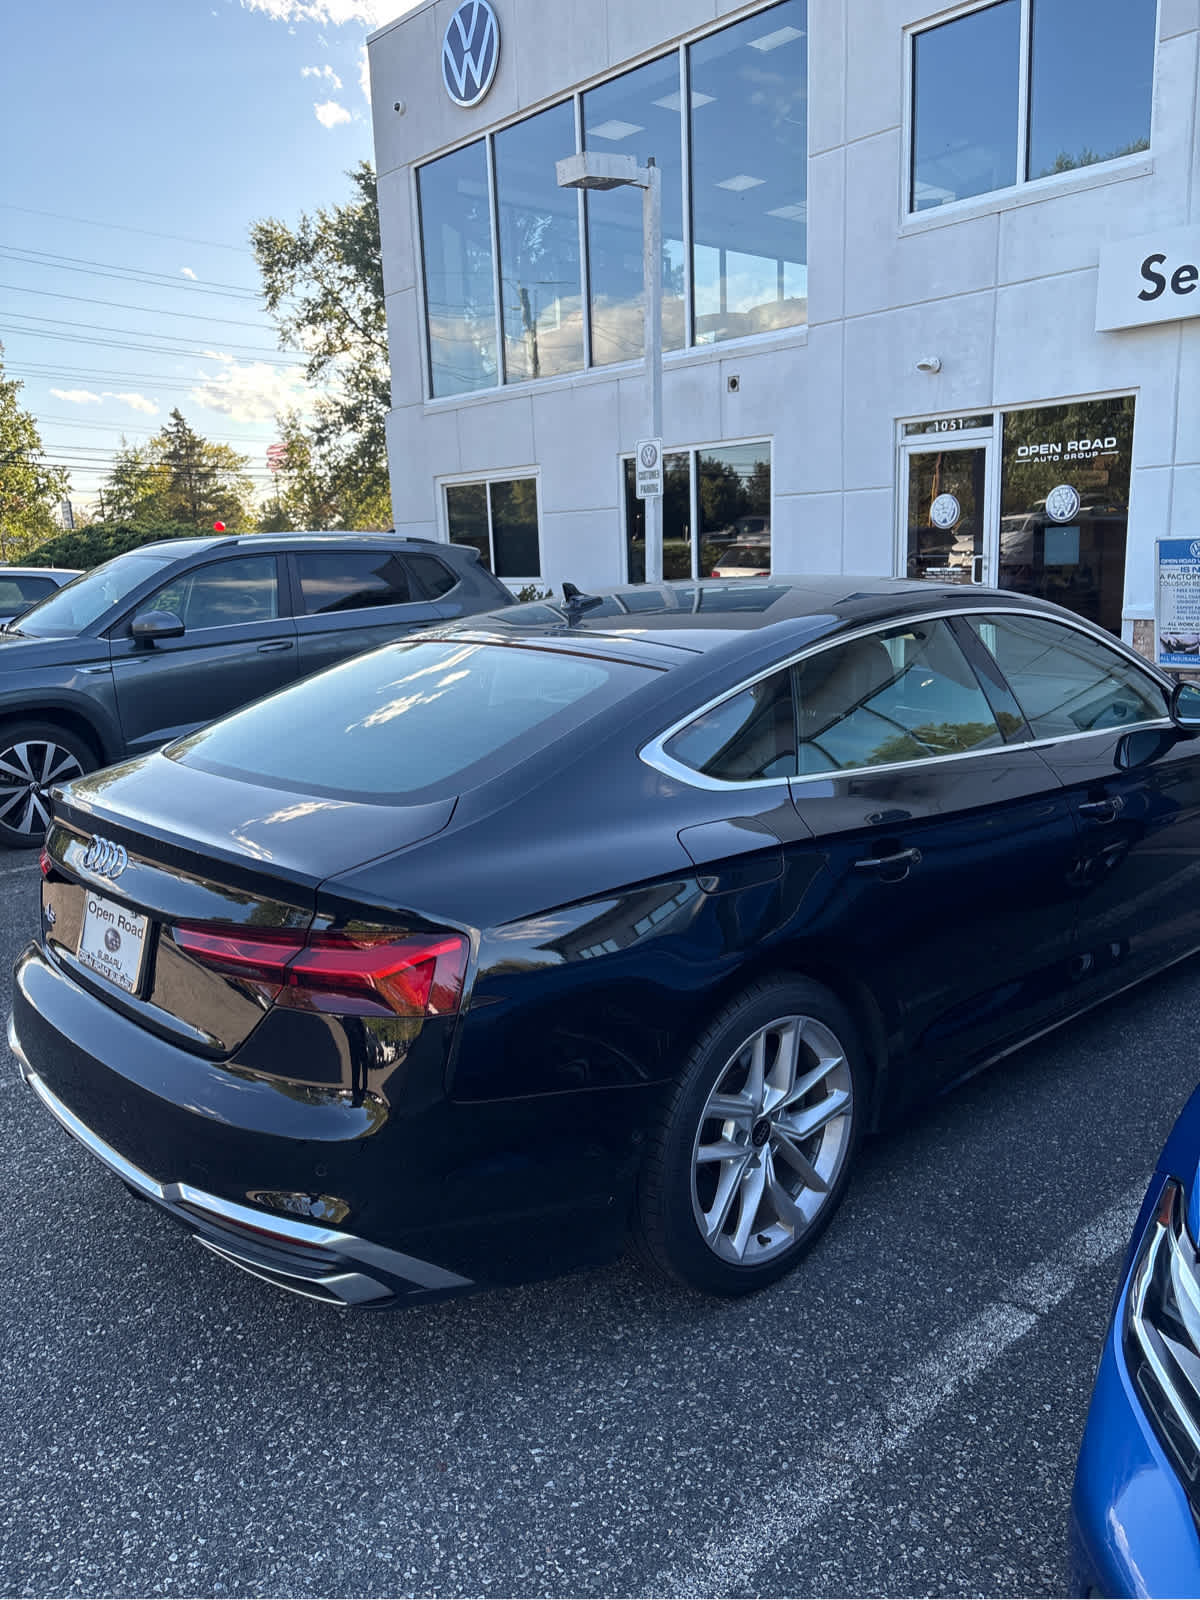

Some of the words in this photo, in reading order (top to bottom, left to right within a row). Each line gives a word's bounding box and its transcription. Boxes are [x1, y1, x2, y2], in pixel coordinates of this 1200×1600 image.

[1137, 253, 1199, 301] Se
[934, 419, 963, 431] 1051
[1017, 443, 1062, 456] OPEN
[1067, 437, 1117, 452] ROAD
[1033, 455, 1060, 463] AUTO
[1064, 451, 1099, 460] GROUP
[88, 901, 115, 923] Open
[118, 915, 144, 939] Road
